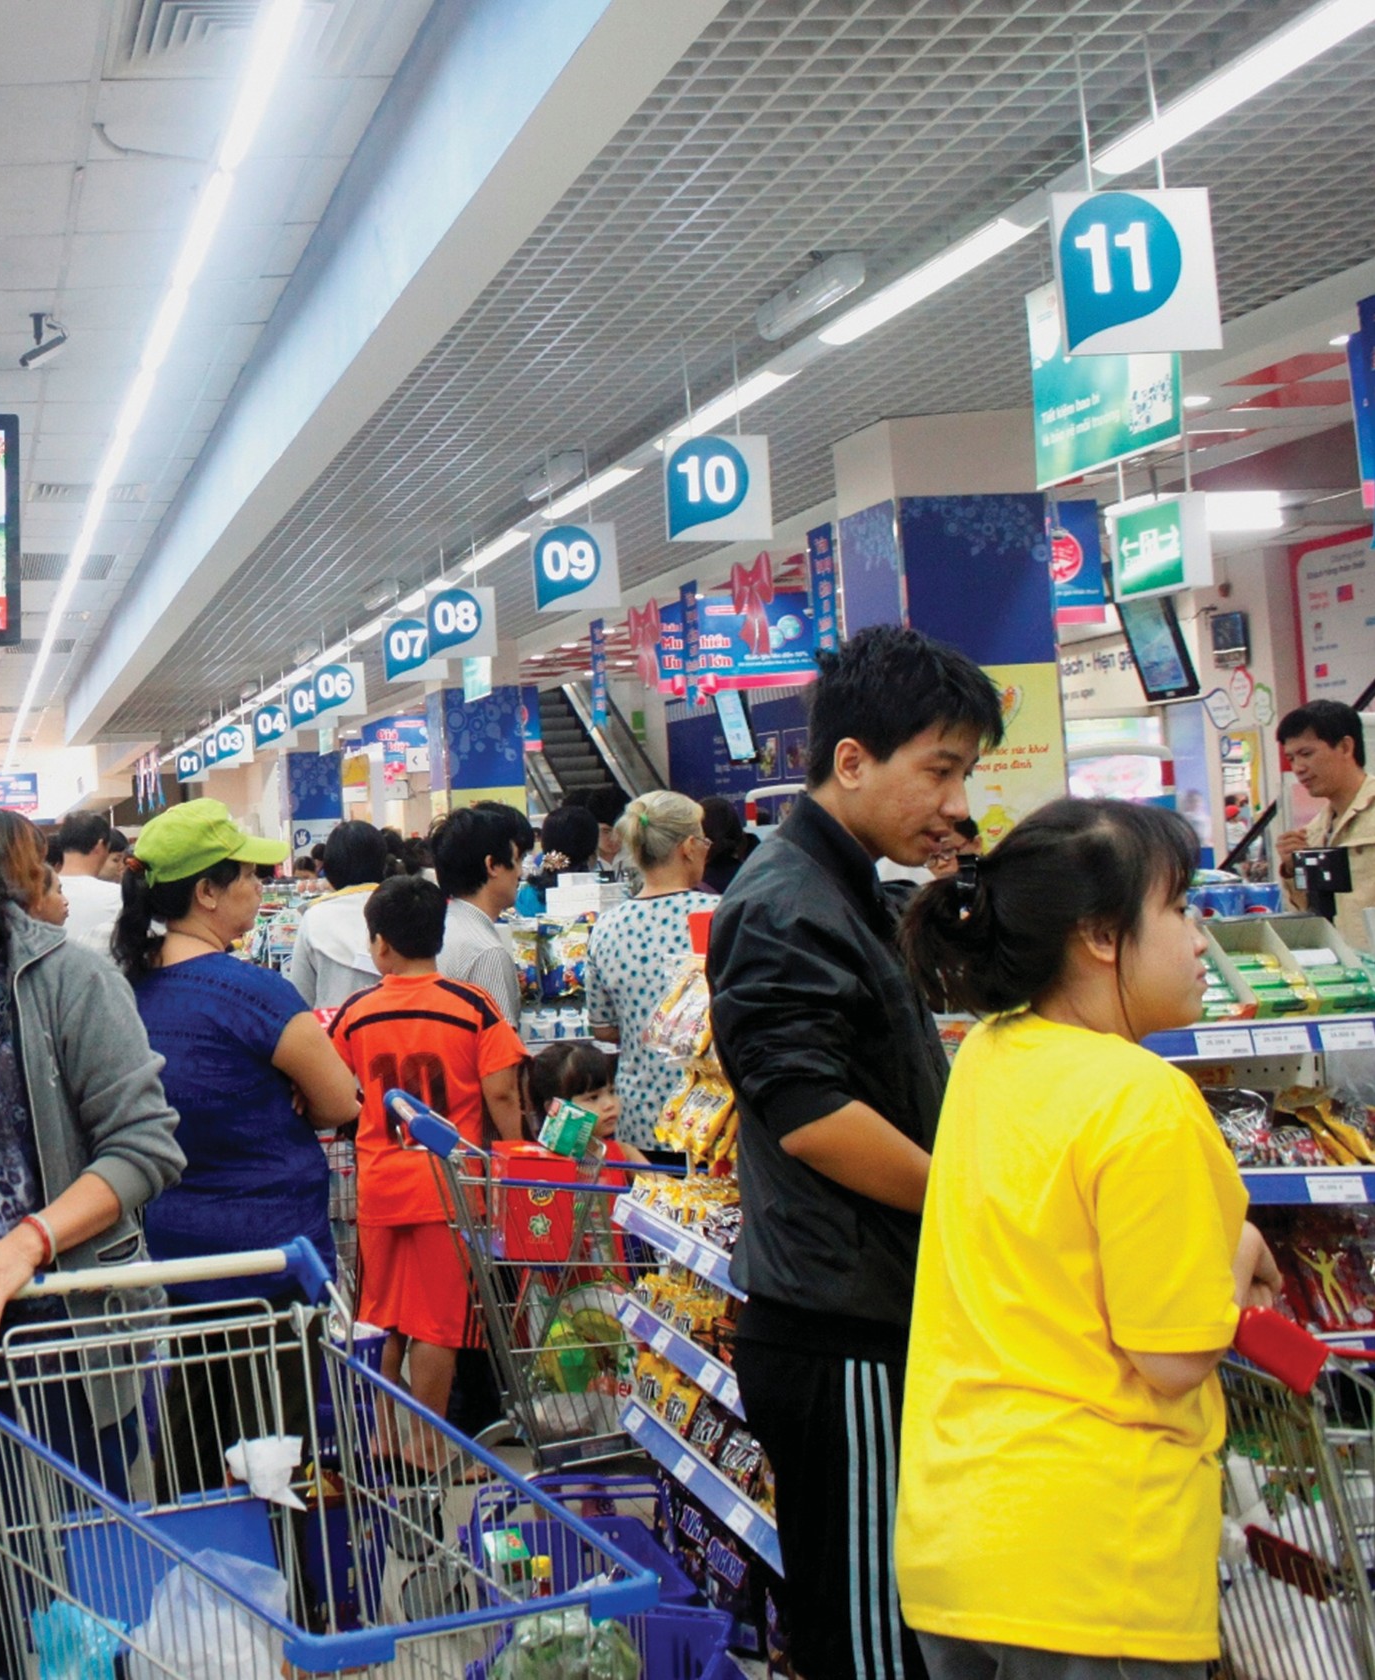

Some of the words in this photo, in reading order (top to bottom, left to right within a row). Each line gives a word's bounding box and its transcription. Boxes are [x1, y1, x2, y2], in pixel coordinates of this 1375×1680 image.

[1075, 222, 1152, 295] 11
[677, 455, 737, 503] 10
[542, 541, 596, 581] 09
[434, 601, 478, 634] 08
[390, 630, 428, 660] 07
[317, 672, 352, 698] 06
[257, 714, 286, 735] 04
[205, 740, 216, 758] 0
[219, 732, 243, 750] 03
[179, 755, 199, 772] 01
[369, 1052, 448, 1146] 10
